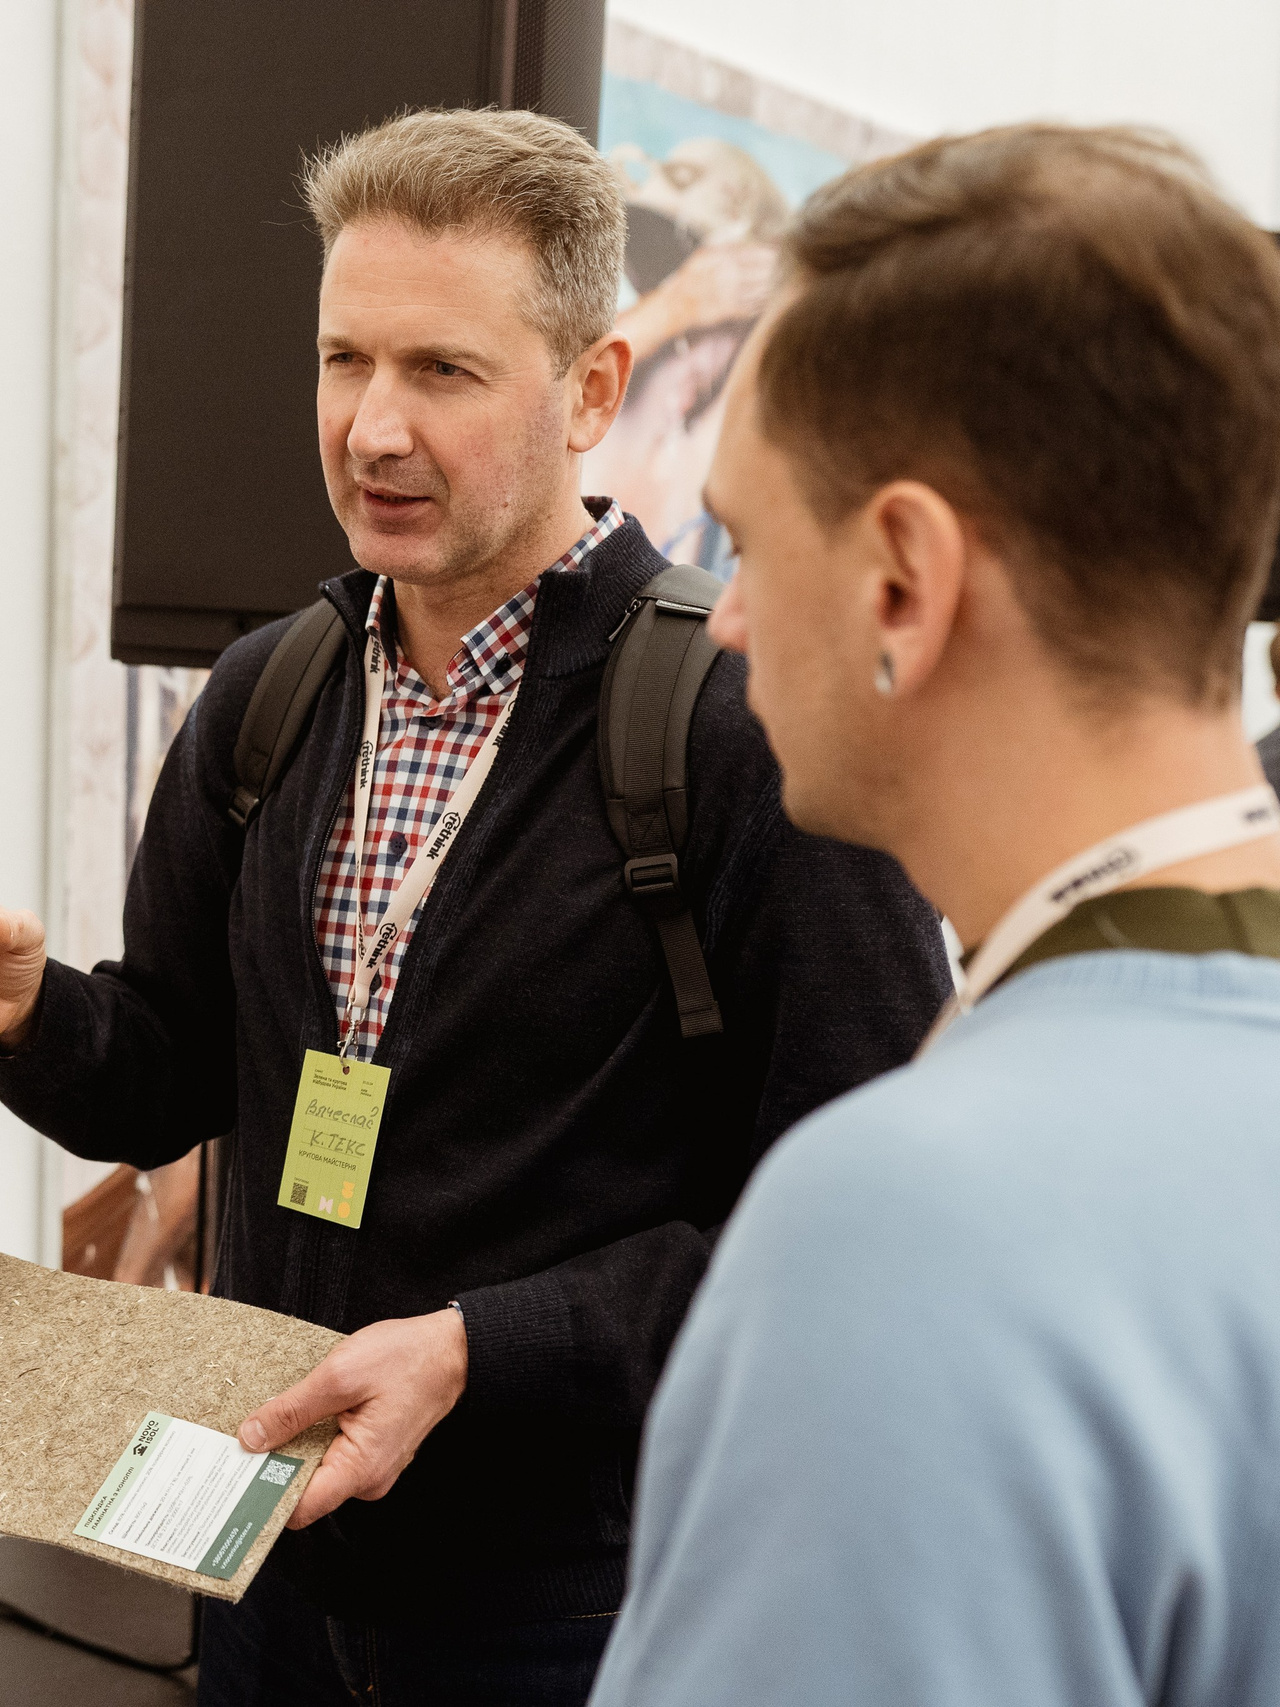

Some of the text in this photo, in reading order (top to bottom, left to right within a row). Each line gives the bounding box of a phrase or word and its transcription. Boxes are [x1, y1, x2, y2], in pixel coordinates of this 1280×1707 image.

[370, 640, 381, 674] ethink
[360, 742, 372, 789] rethink
[426, 814, 459, 860] rethink
[366, 924, 395, 968] rethink
[299, 1150, 357, 1171] КРУГОВА МАЙСТЕРНЯ
[138, 1420, 155, 1442] NOVO
[84, 1495, 107, 1528] ПІДКЛАДКА
[91, 1497, 115, 1531] ЛАМІНАТНА
[116, 1466, 134, 1492] КОНОПЛІ
